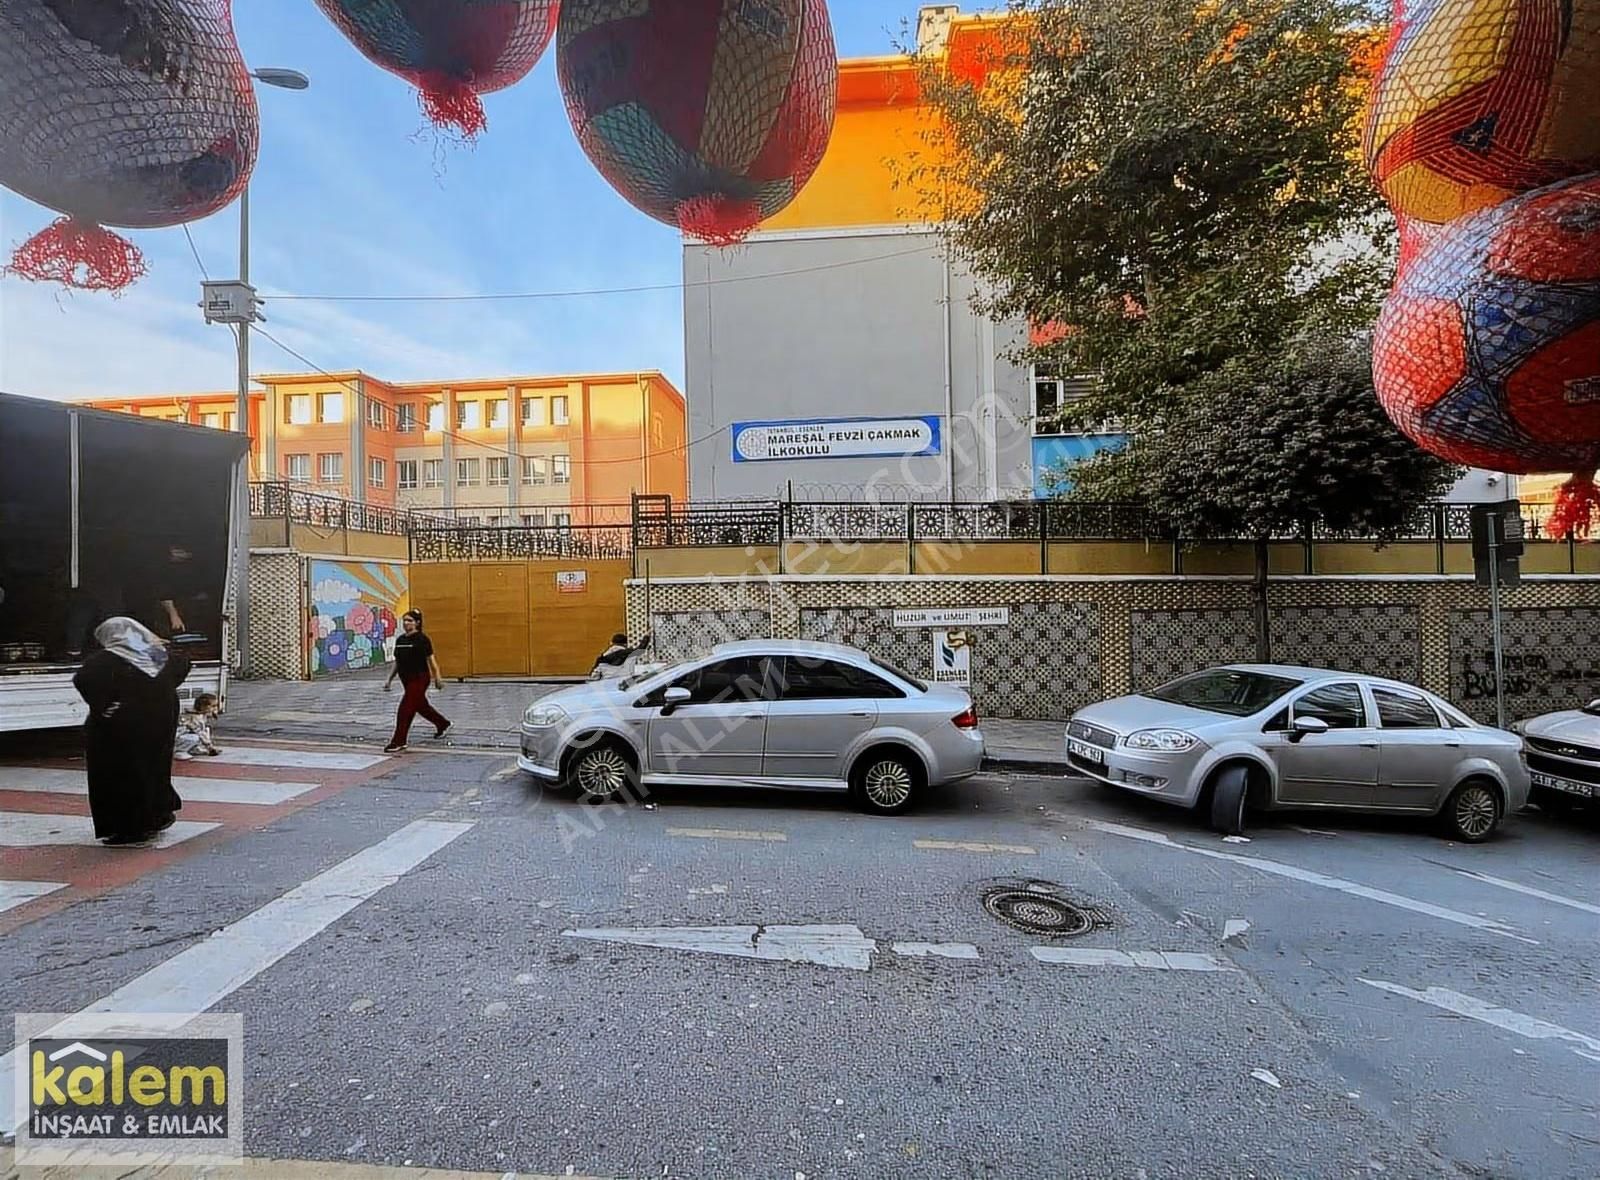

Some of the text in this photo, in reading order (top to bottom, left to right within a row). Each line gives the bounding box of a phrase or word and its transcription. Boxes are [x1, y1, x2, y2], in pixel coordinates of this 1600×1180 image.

[767, 428, 920, 445] MAREŞAL FEVZİ ÇAKMAK
[768, 444, 830, 457] İLKOKULU
[896, 613, 927, 622] HUZUR
